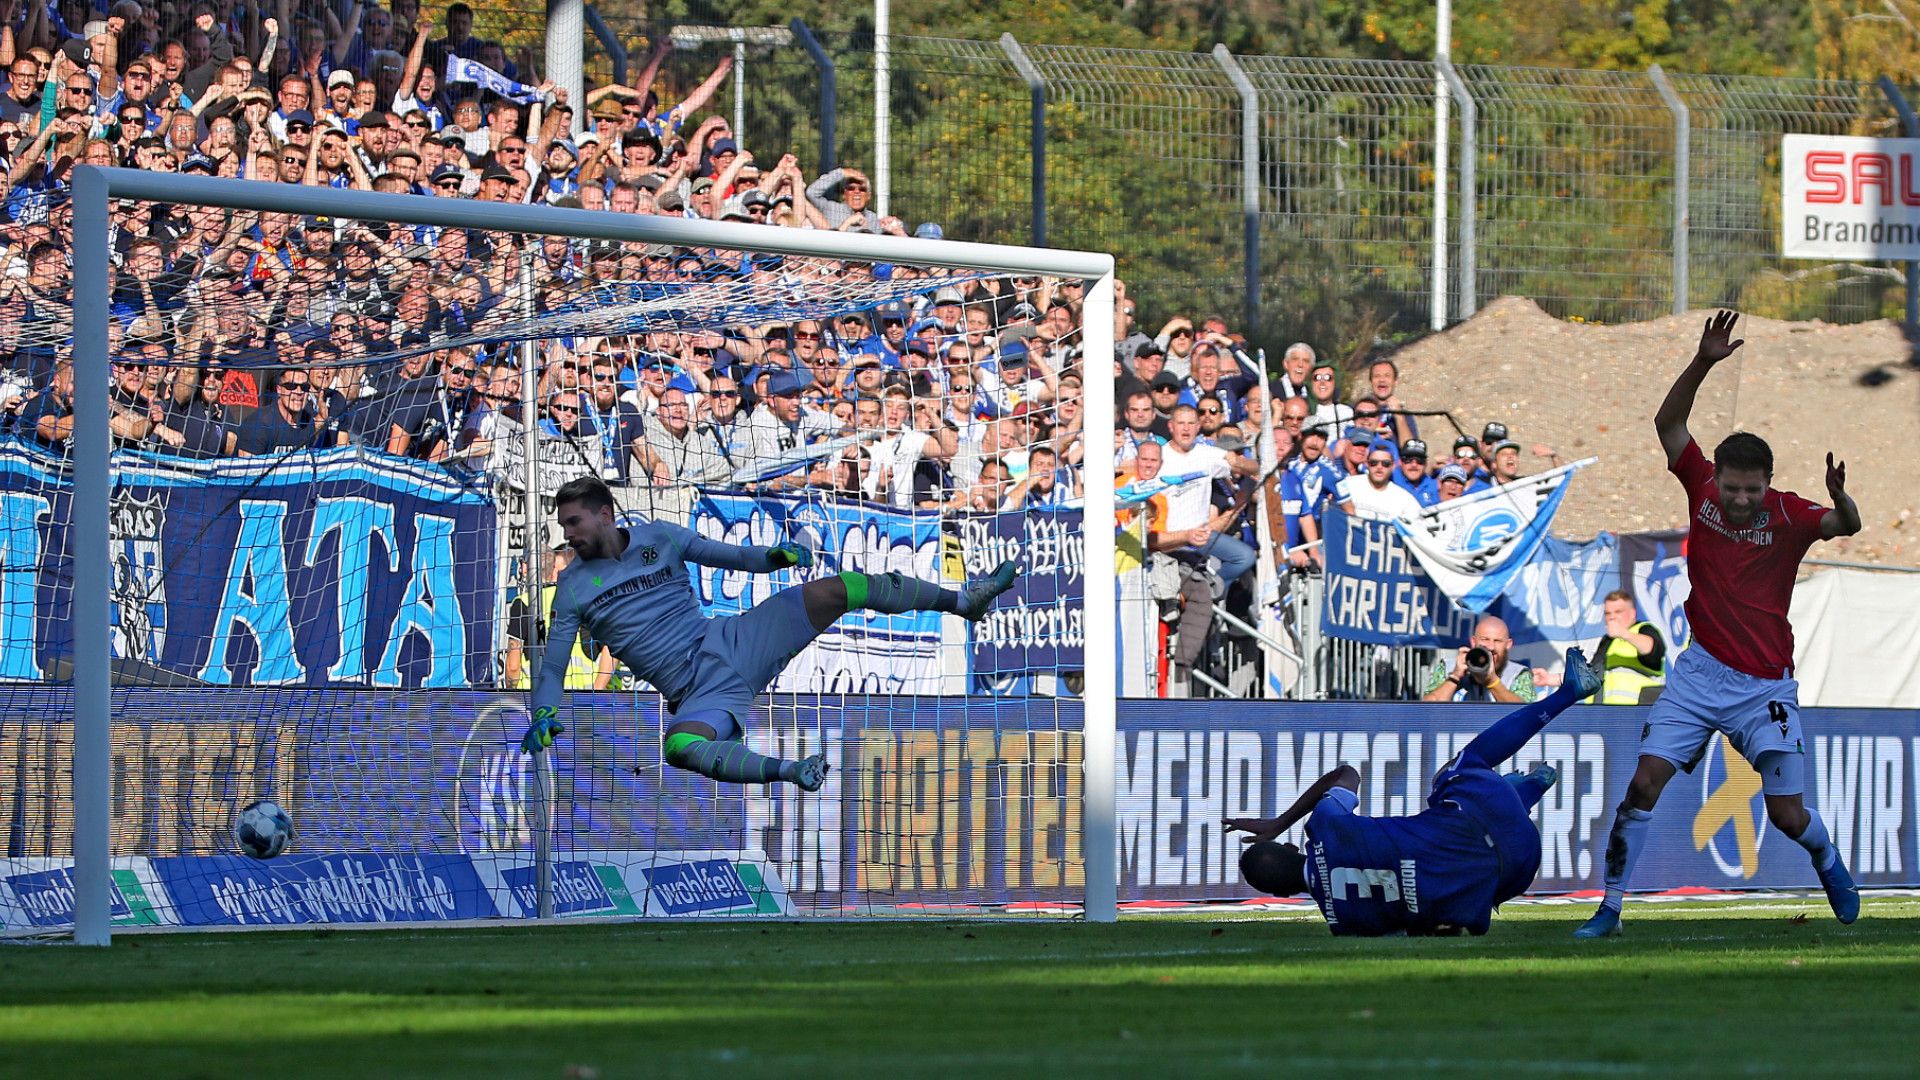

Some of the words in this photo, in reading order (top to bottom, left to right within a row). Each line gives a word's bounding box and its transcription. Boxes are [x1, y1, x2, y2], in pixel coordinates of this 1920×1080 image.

[220, 392, 257, 405] adidas
[1699, 497, 1724, 526] HEIN
[642, 544, 659, 566] 96
[620, 580, 640, 595] VON
[639, 566, 673, 591] HEIDEN
[1768, 700, 1789, 724] 4
[1774, 766, 1781, 778] 4
[745, 728, 843, 892] EIN
[857, 728, 1086, 890] DRITTEL
[1116, 731, 1263, 886] MEHR
[1814, 735, 1904, 874] WIR
[1312, 841, 1325, 856] SC
[210, 857, 455, 924] www.wohlfeil.de
[515, 863, 604, 909] whlfeil
[656, 863, 744, 908] wohlfeil
[1330, 867, 1401, 903] 3
[1400, 859, 1419, 914] GORDON
